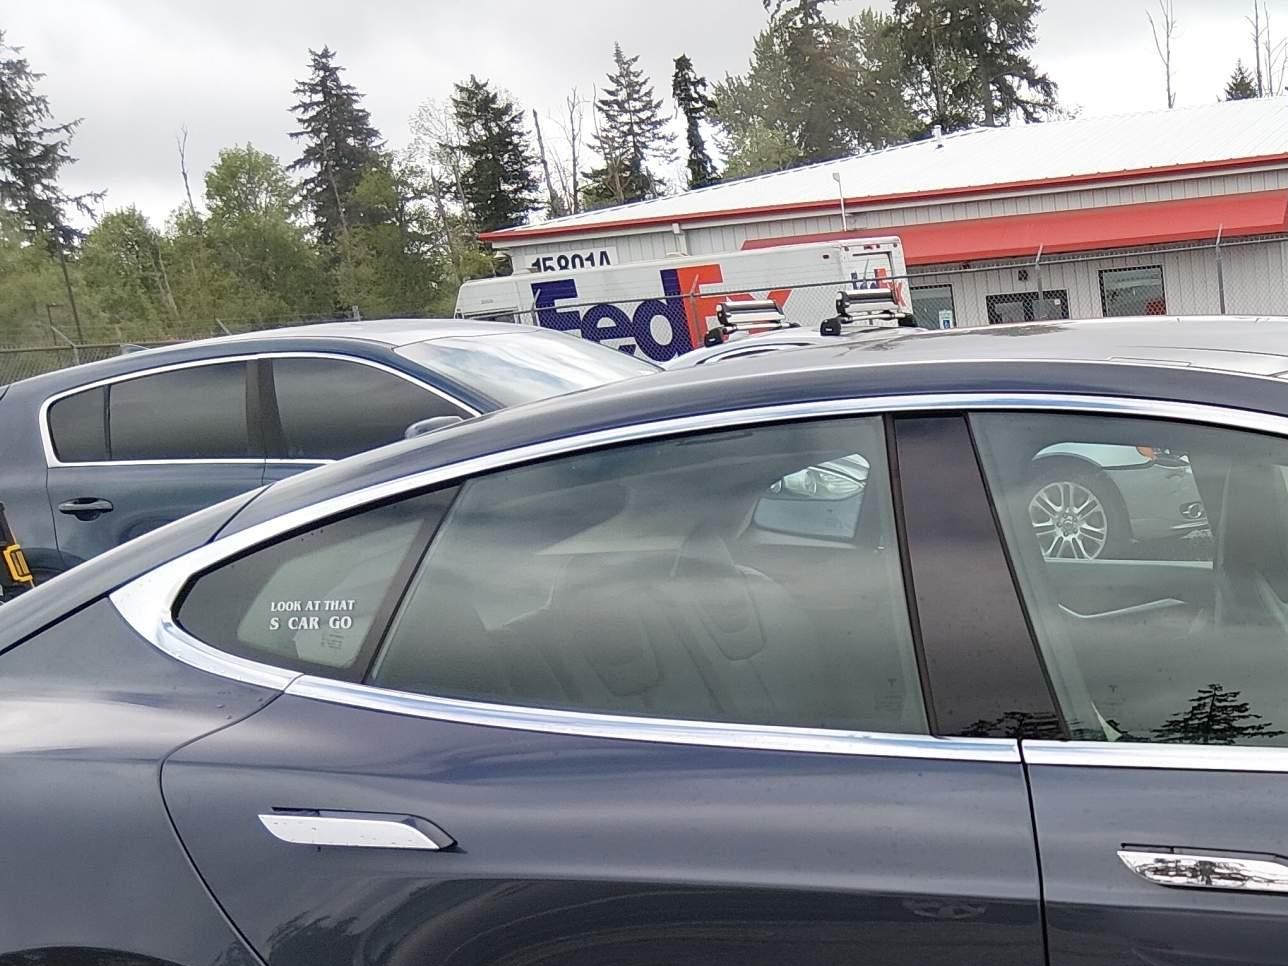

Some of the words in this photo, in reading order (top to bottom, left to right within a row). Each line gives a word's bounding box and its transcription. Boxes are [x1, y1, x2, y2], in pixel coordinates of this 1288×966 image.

[531, 264, 792, 362] FedEx
[271, 601, 301, 612] LOOK
[305, 601, 320, 611] AT
[324, 600, 355, 611] THAT
[269, 617, 280, 630] S
[288, 616, 319, 630] CAR
[329, 615, 352, 629] GO
